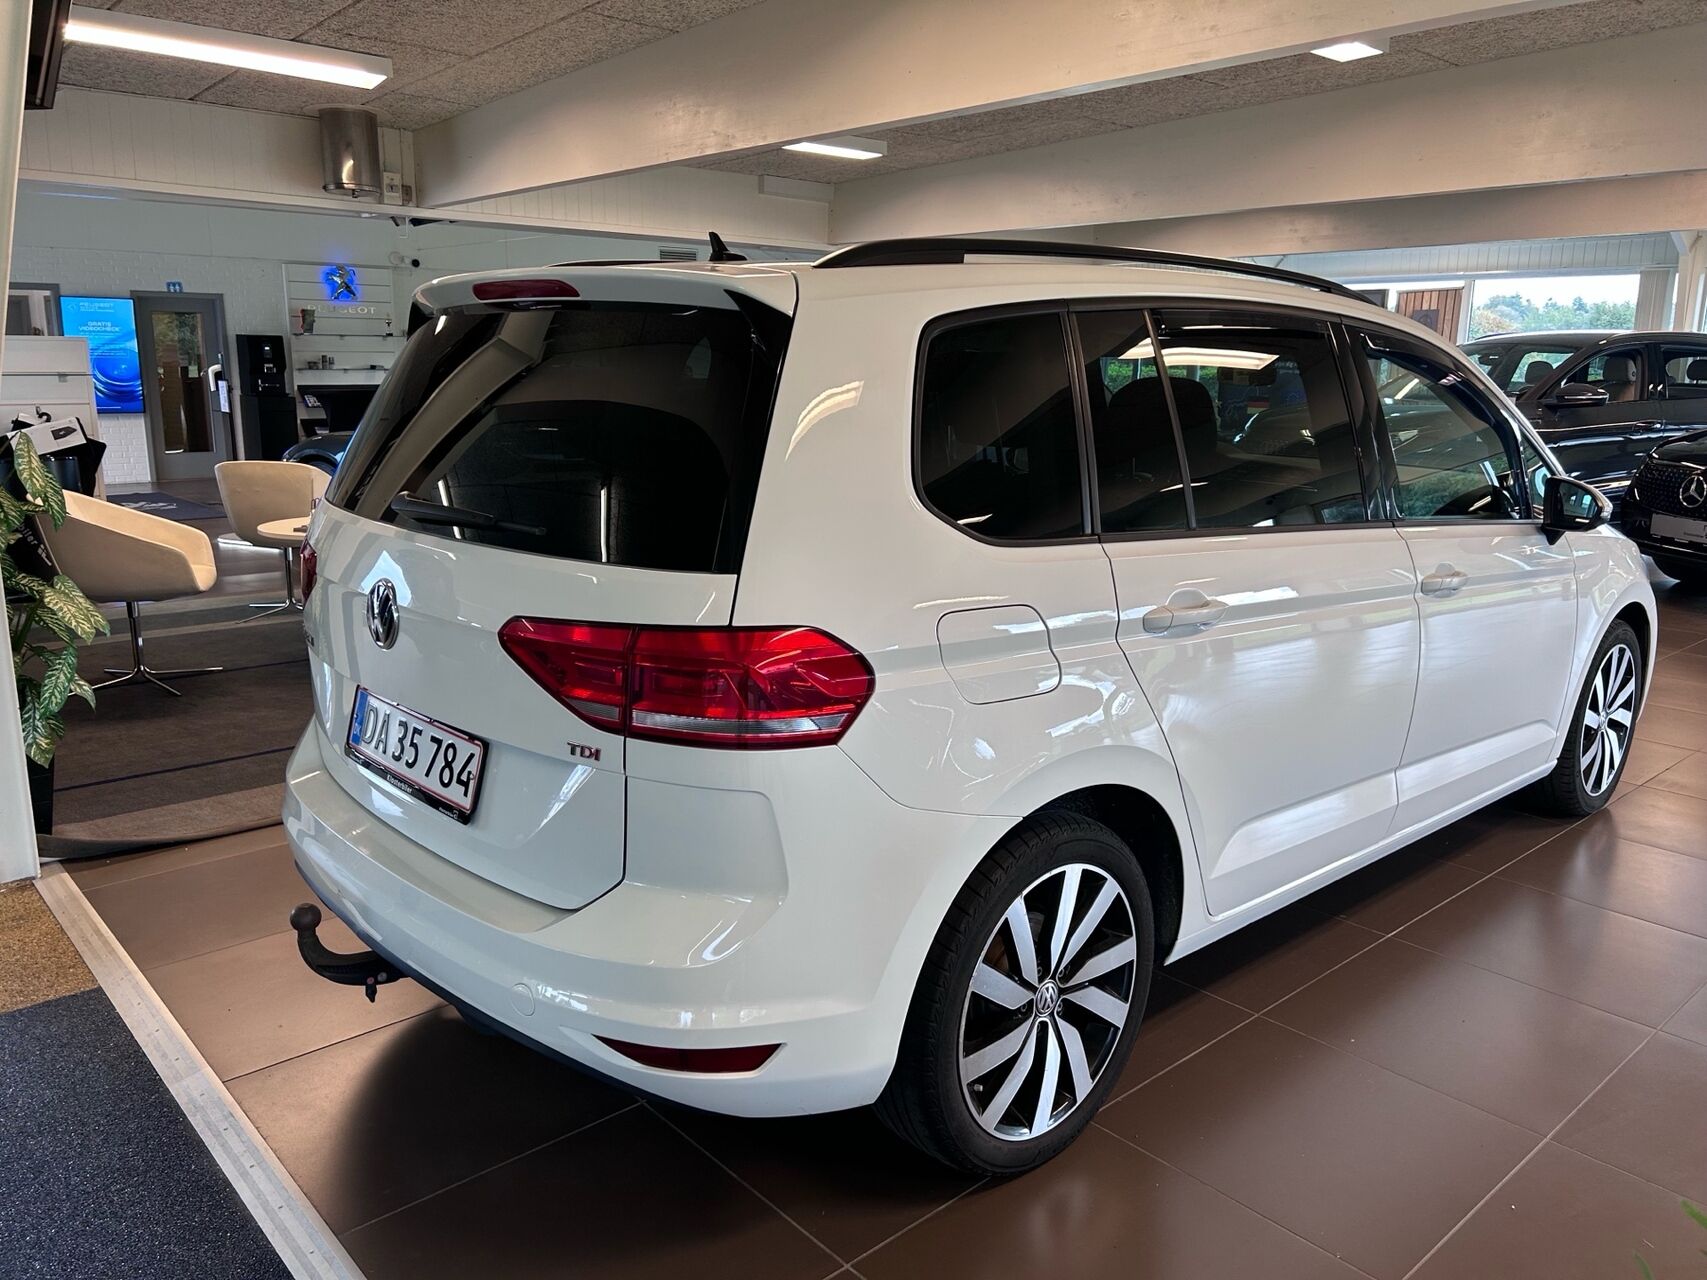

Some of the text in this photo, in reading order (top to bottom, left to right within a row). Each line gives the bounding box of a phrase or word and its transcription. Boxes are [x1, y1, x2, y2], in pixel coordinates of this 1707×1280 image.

[361, 703, 475, 798] DA 35 784
[567, 741, 602, 761] TDI
